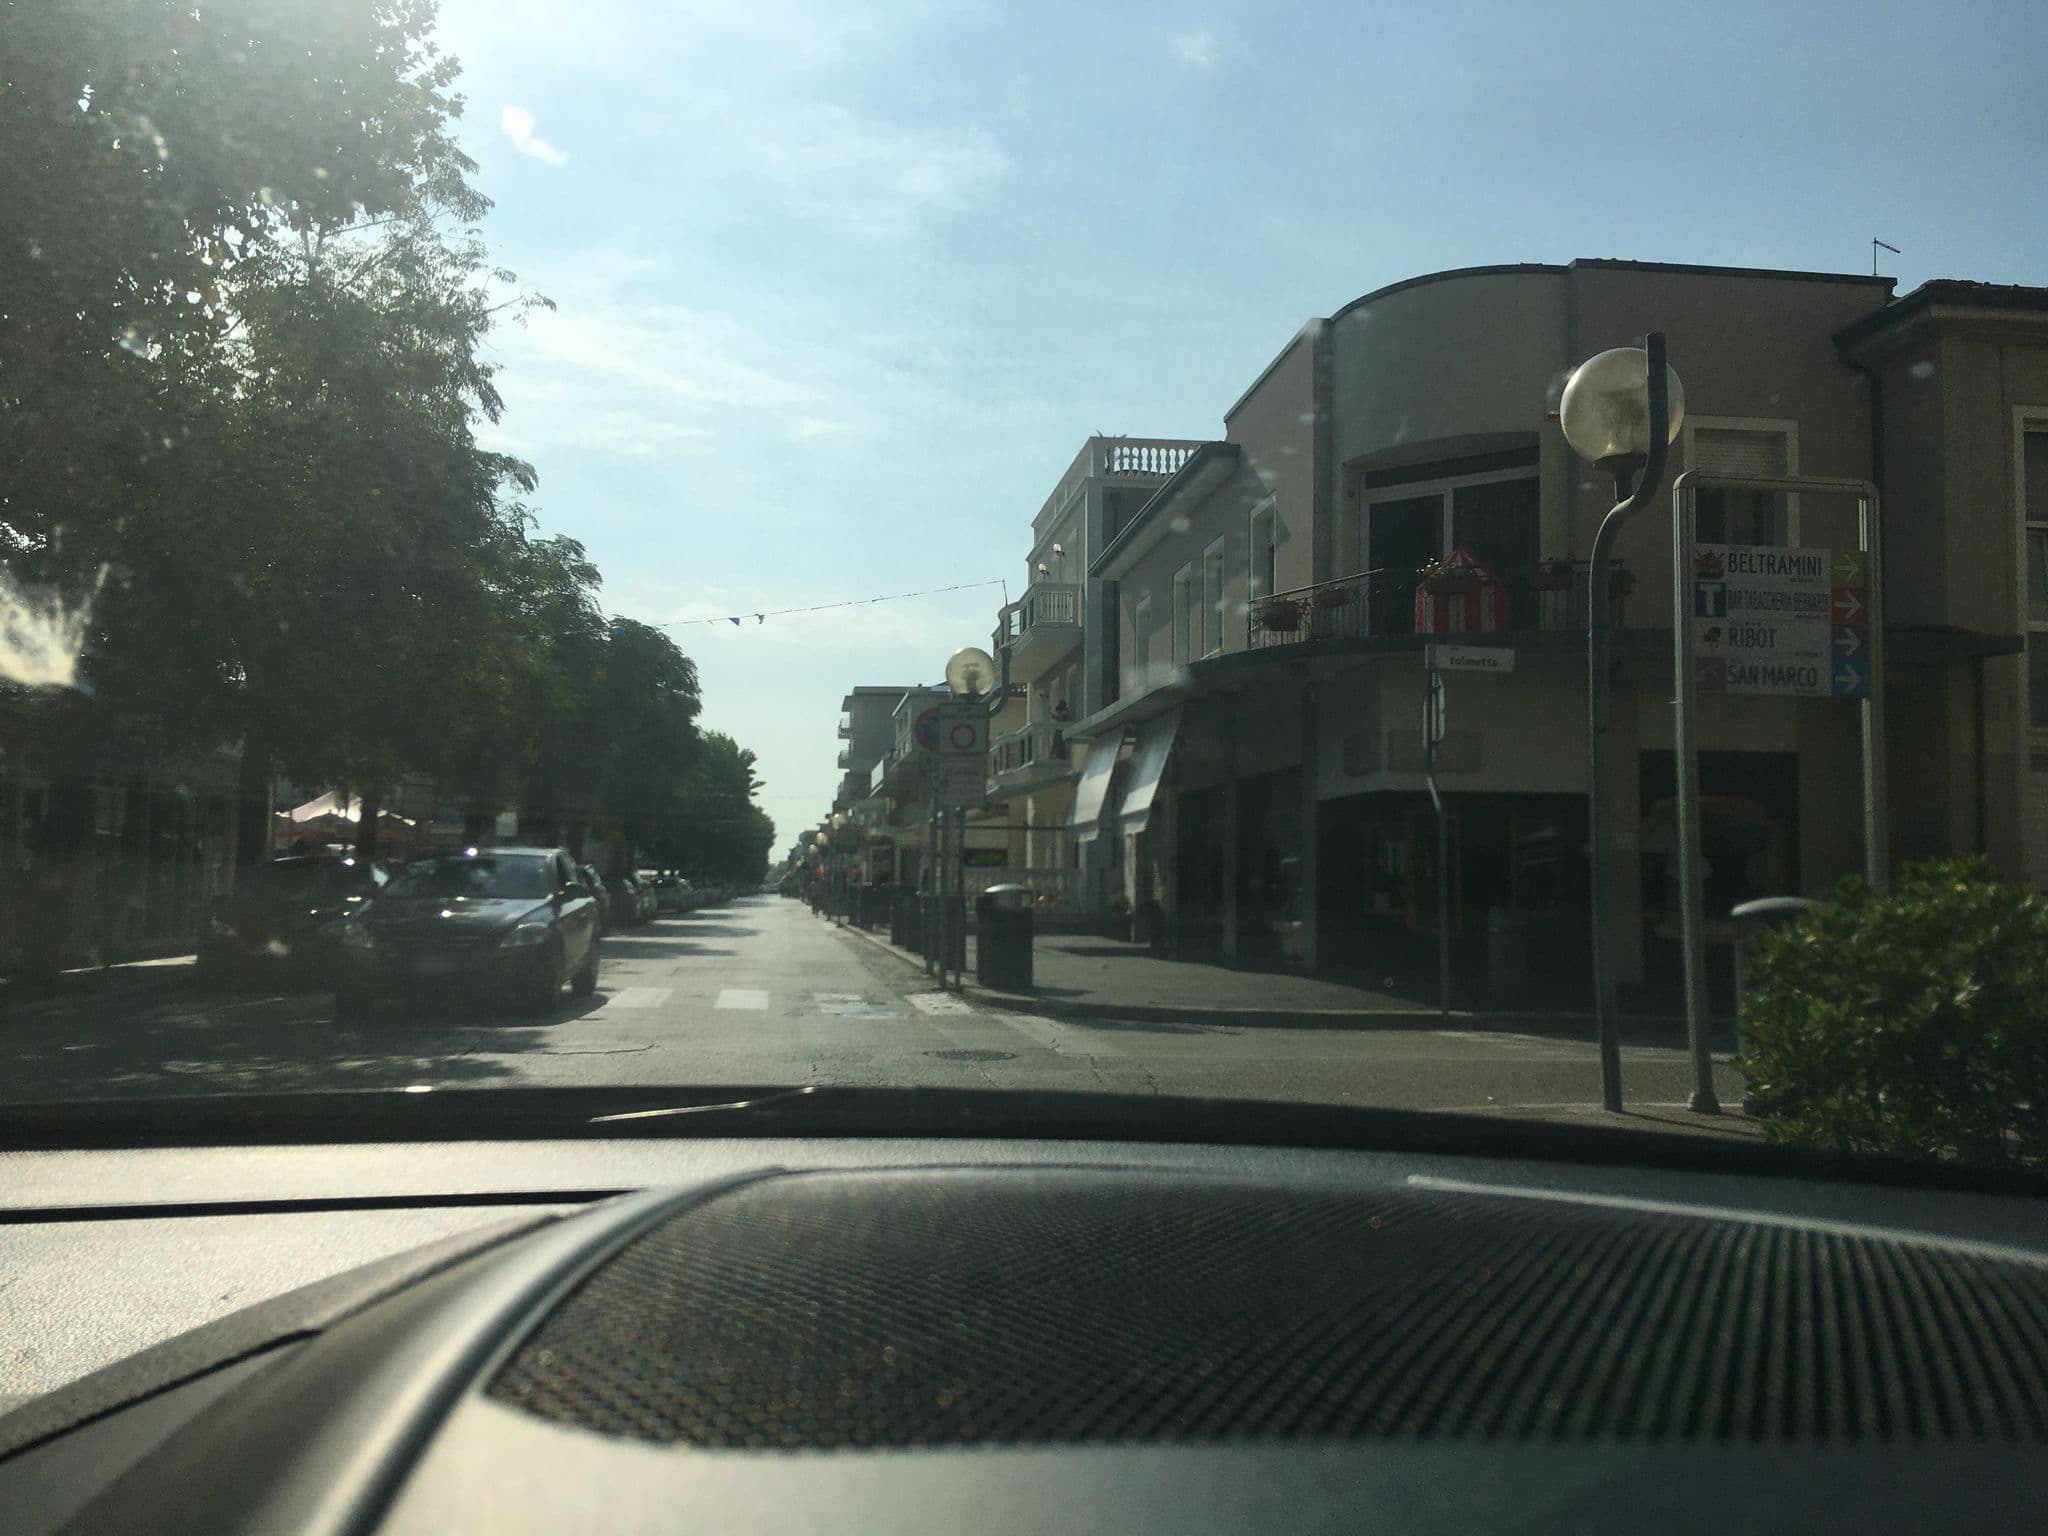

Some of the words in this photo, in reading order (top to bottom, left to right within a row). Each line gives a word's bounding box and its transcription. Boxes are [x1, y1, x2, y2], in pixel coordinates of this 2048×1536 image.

[1727, 552, 1822, 577] BELTRAMINI
[1728, 627, 1777, 649] RIBOT
[1727, 664, 1759, 686] SAN
[1761, 665, 1818, 688] MARCO
